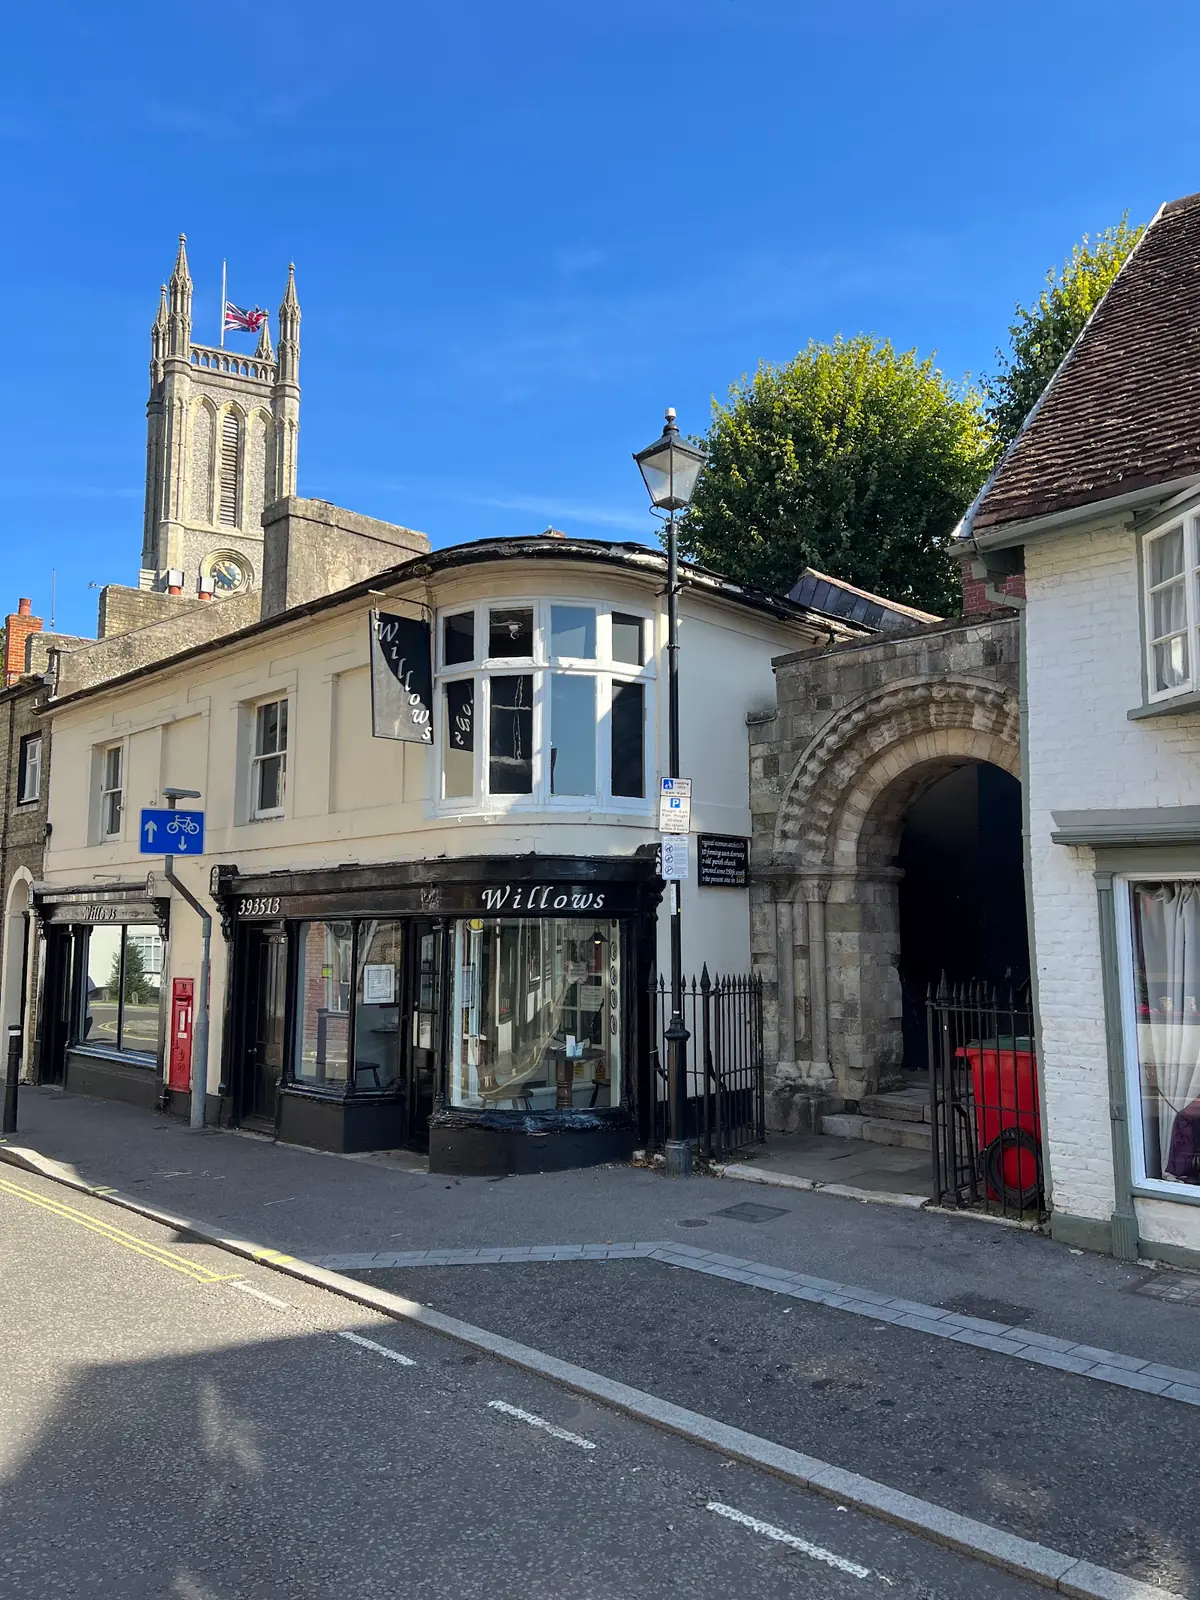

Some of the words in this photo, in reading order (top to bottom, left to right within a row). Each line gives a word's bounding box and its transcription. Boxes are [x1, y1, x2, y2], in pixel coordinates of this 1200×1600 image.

[373, 619, 433, 740] Willows
[237, 897, 281, 915] 393513
[481, 884, 606, 910] Willows
